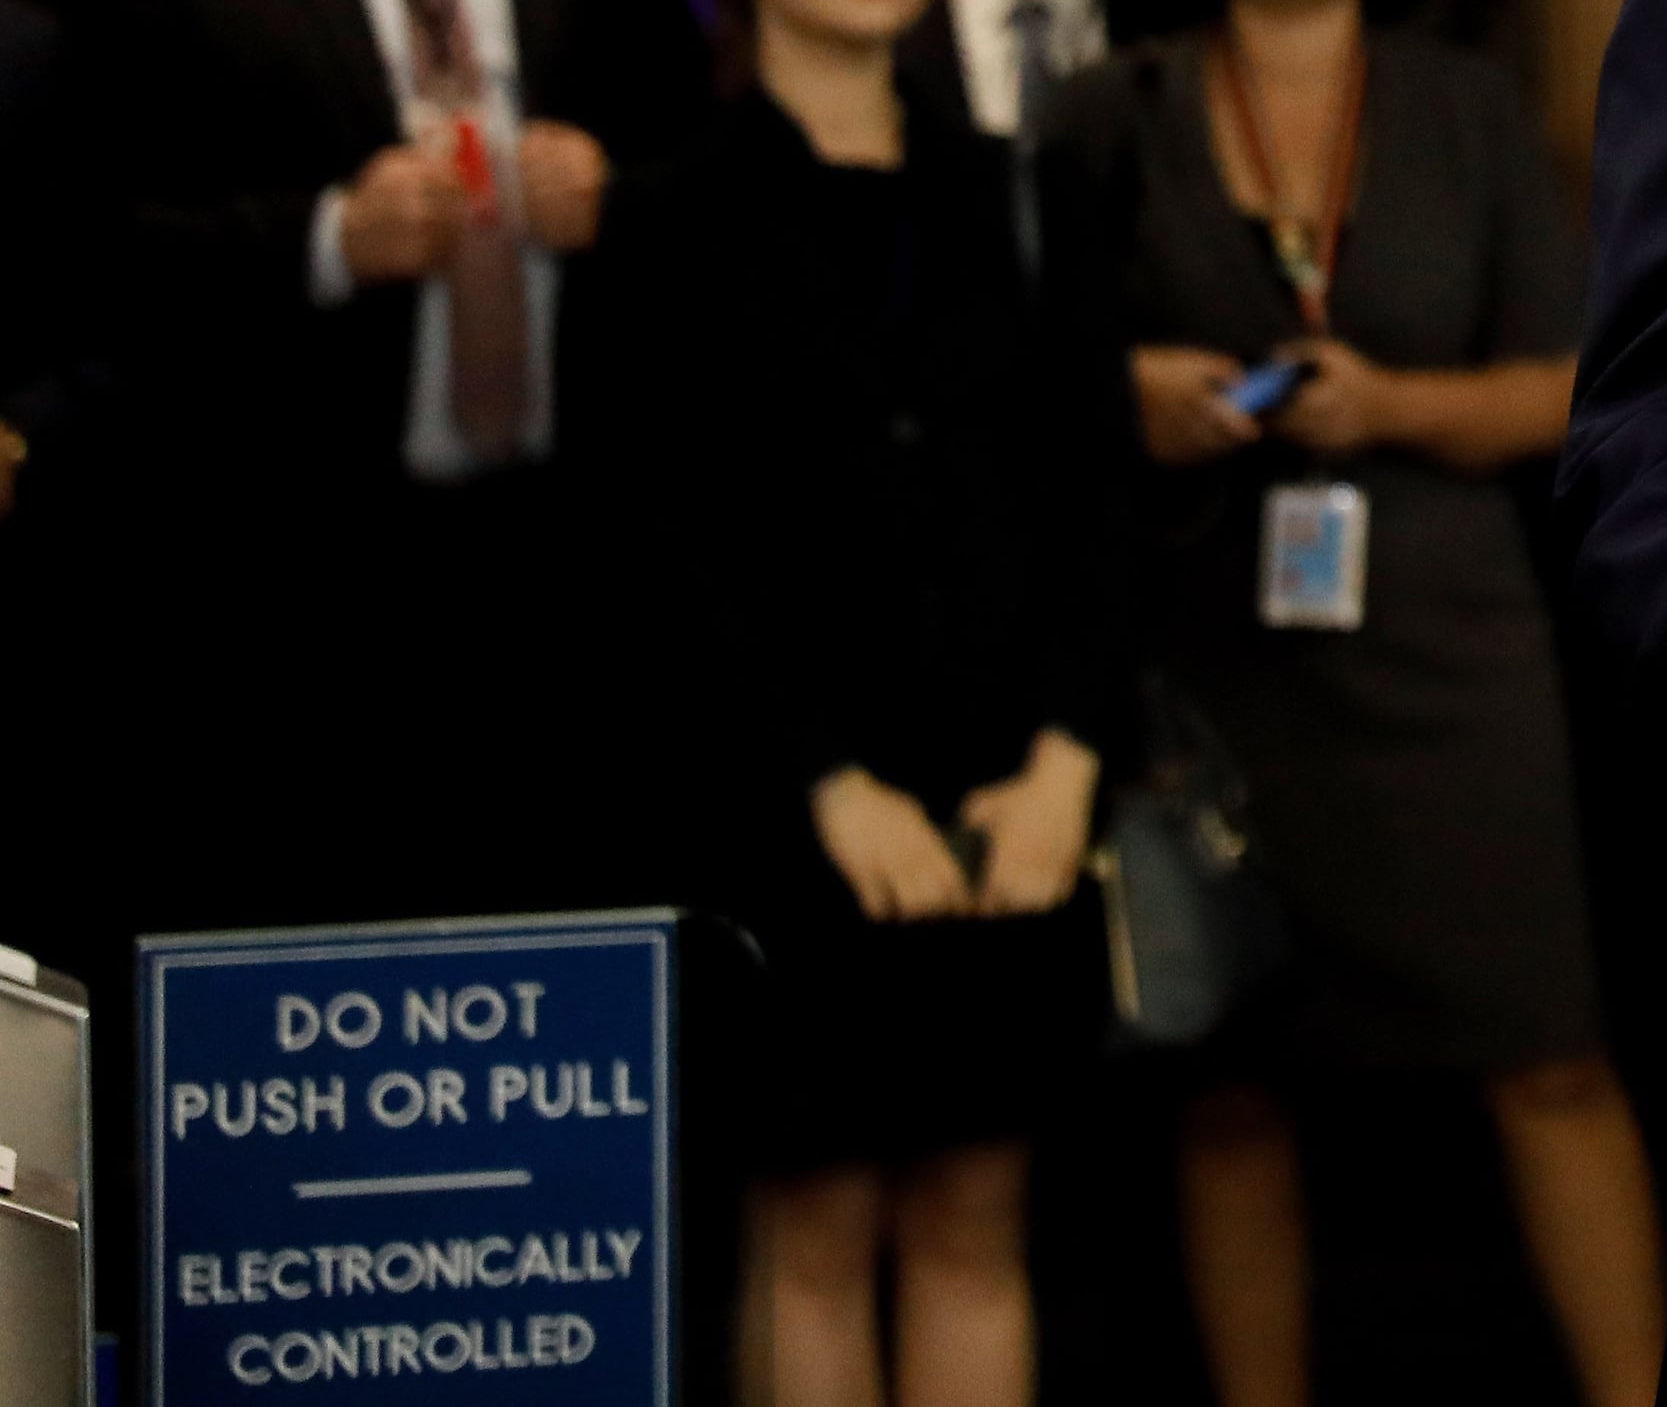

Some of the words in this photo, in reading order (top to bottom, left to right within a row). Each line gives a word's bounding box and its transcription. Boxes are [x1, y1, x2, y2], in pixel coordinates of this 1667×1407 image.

[277, 991, 383, 1051] DO
[404, 982, 544, 1043] NOT
[171, 1078, 346, 1139] PUSH
[368, 1068, 468, 1127] OR
[490, 1062, 648, 1120] PULL
[180, 1232, 642, 1305] ELECTRONICALLY
[230, 1313, 596, 1383] CONTROLLED
